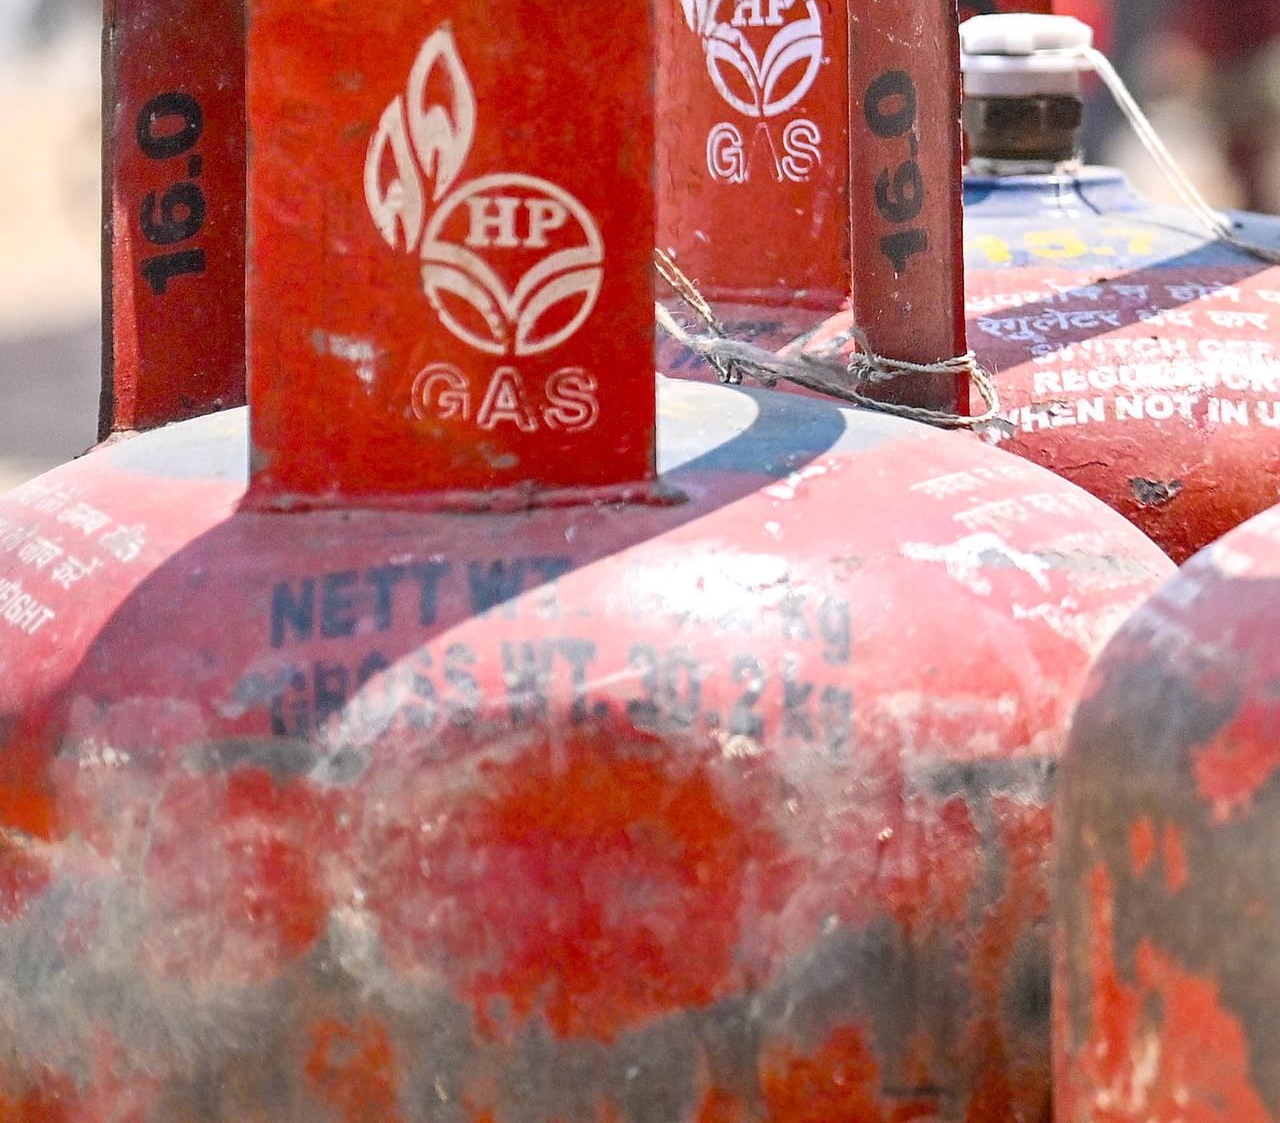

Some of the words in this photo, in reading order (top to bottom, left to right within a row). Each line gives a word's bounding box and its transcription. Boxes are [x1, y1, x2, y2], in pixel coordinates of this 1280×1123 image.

[705, 119, 823, 183] GAS
[864, 70, 928, 281] 16.0
[135, 91, 208, 297] 16.0
[464, 197, 570, 248] HP
[410, 362, 600, 432] GAS
[1114, 393, 1203, 423] NOT
[1208, 396, 1250, 427] IN
[270, 561, 452, 649] NETT
